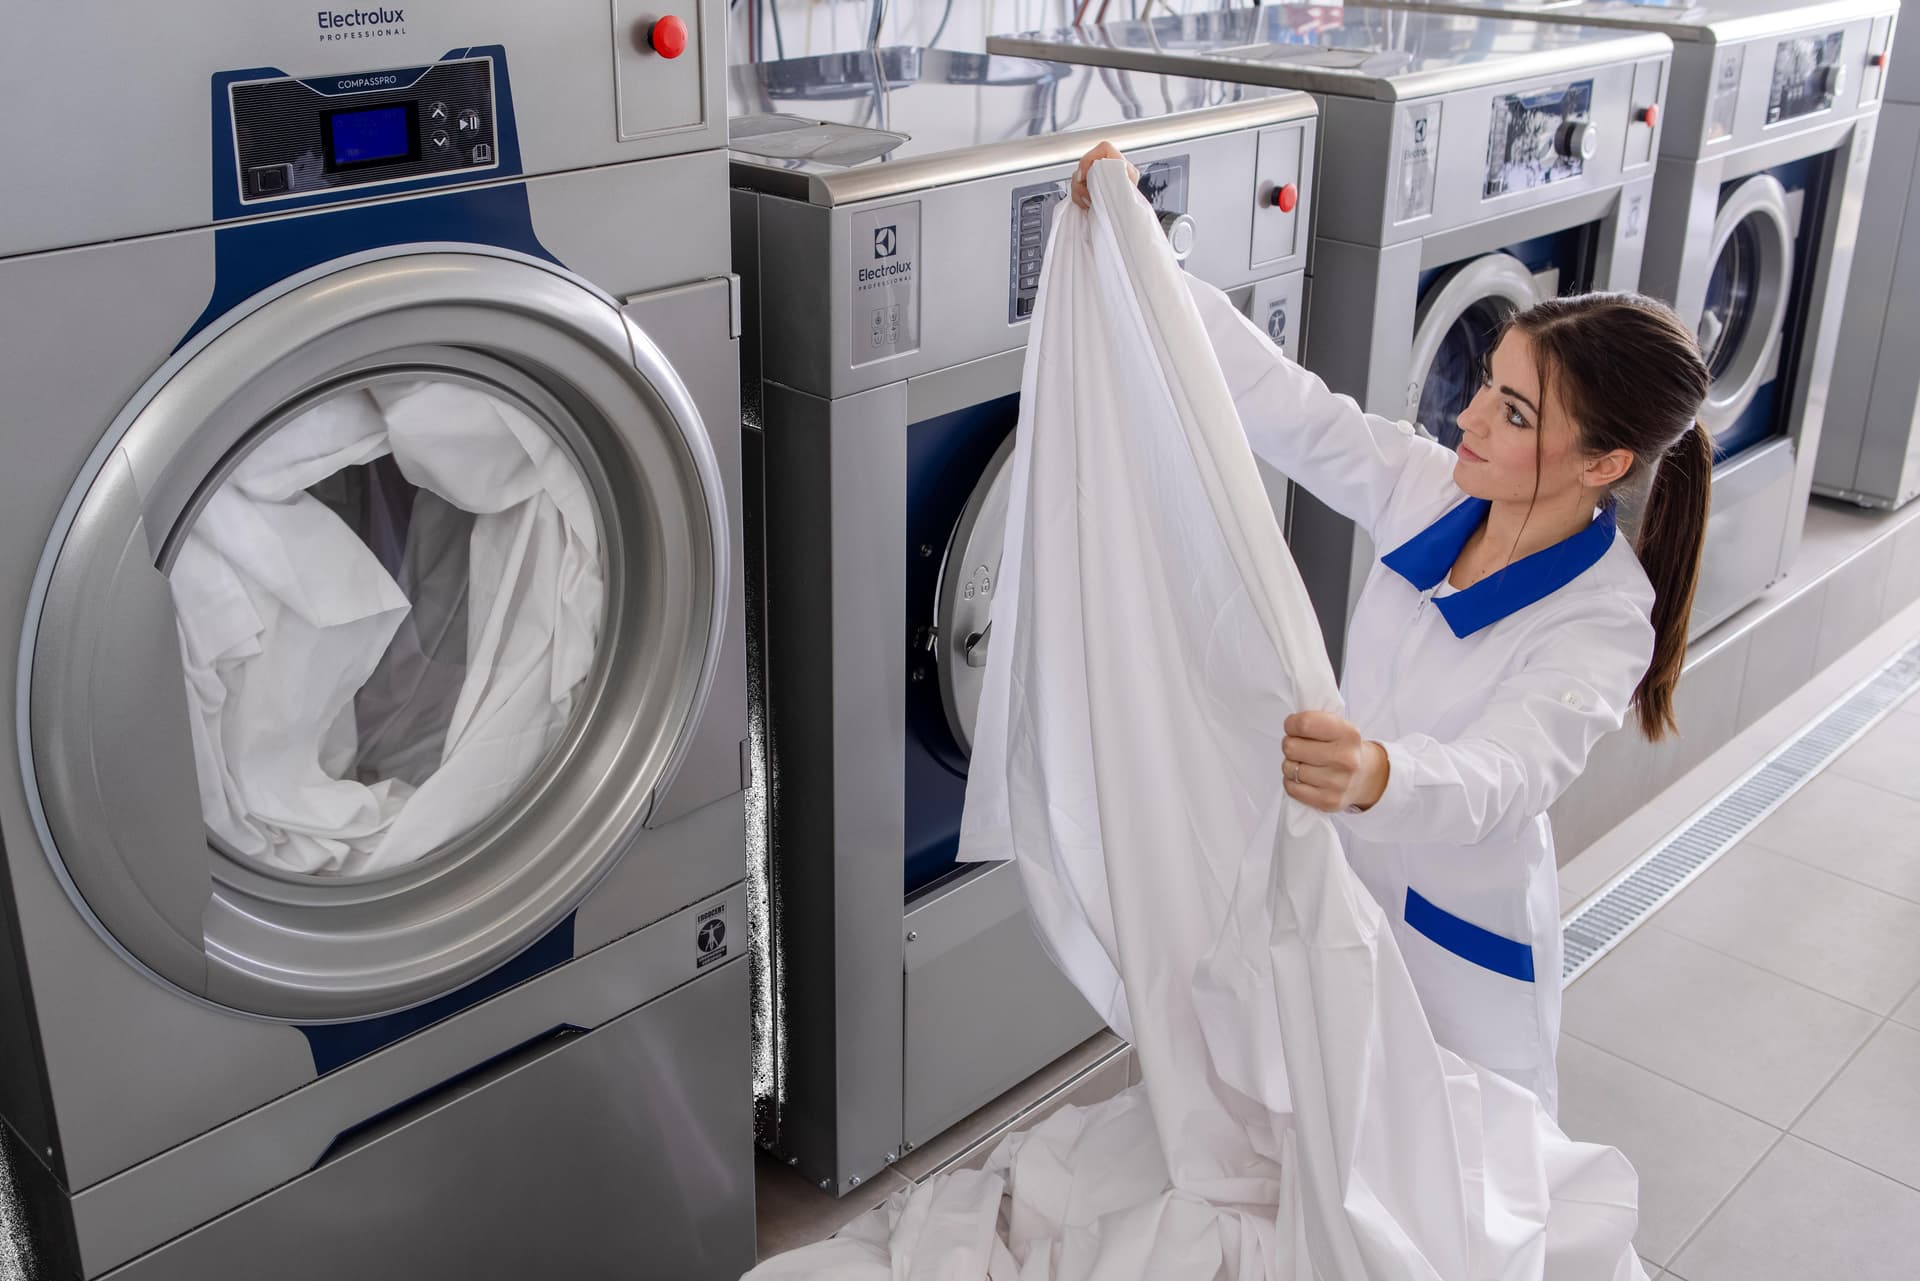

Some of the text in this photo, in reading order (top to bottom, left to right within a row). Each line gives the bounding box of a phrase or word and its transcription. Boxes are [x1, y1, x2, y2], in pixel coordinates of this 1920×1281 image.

[318, 7, 405, 28] Electrolux
[320, 28, 406, 41] PROFESSIONAL
[338, 75, 397, 89] COMPASSPRO
[858, 261, 911, 282] Electrolux
